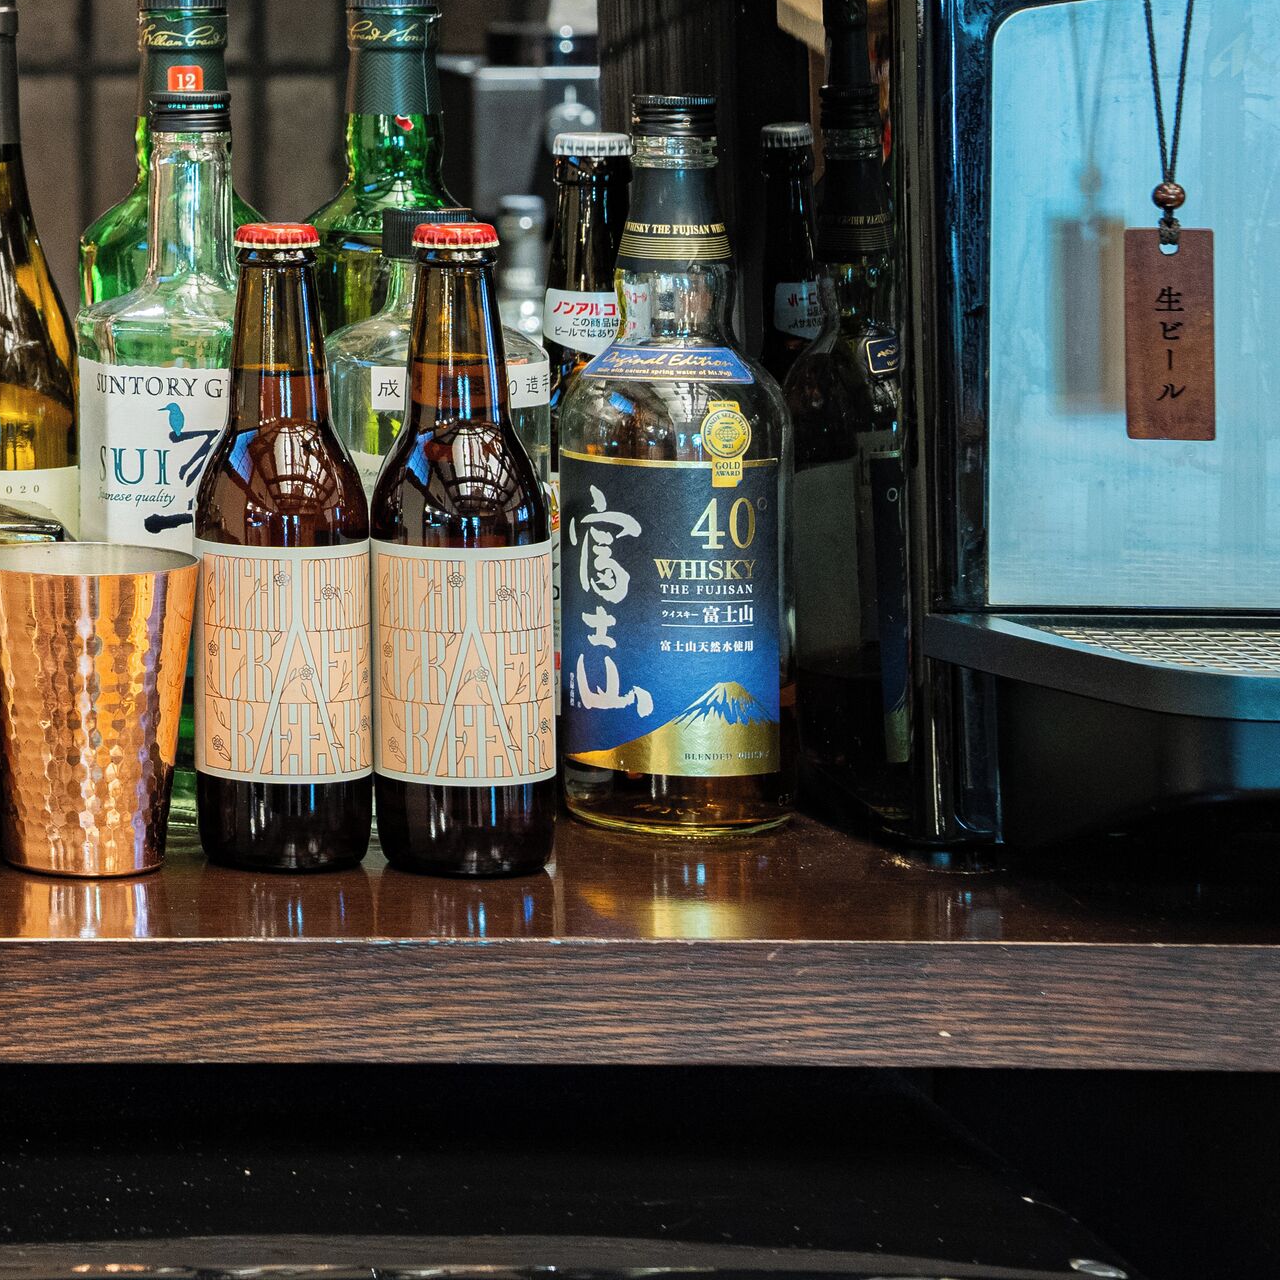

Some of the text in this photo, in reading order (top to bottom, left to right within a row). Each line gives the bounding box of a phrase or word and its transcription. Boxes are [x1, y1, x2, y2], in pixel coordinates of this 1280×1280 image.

[176, 73, 196, 90] 12
[652, 223, 671, 235] THE
[672, 223, 710, 237] FUJISAN
[1154, 286, 1186, 402] 生ビール
[96, 373, 199, 397] SUNTORY
[715, 461, 741, 470] GOLD
[134, 488, 176, 508] quality
[653, 559, 757, 581] WHISKY
[660, 584, 754, 595] THE FUJISAN
[702, 605, 754, 624] 富士山
[660, 640, 754, 653] 富士山天然水使用
[684, 752, 733, 762] BLENDED
